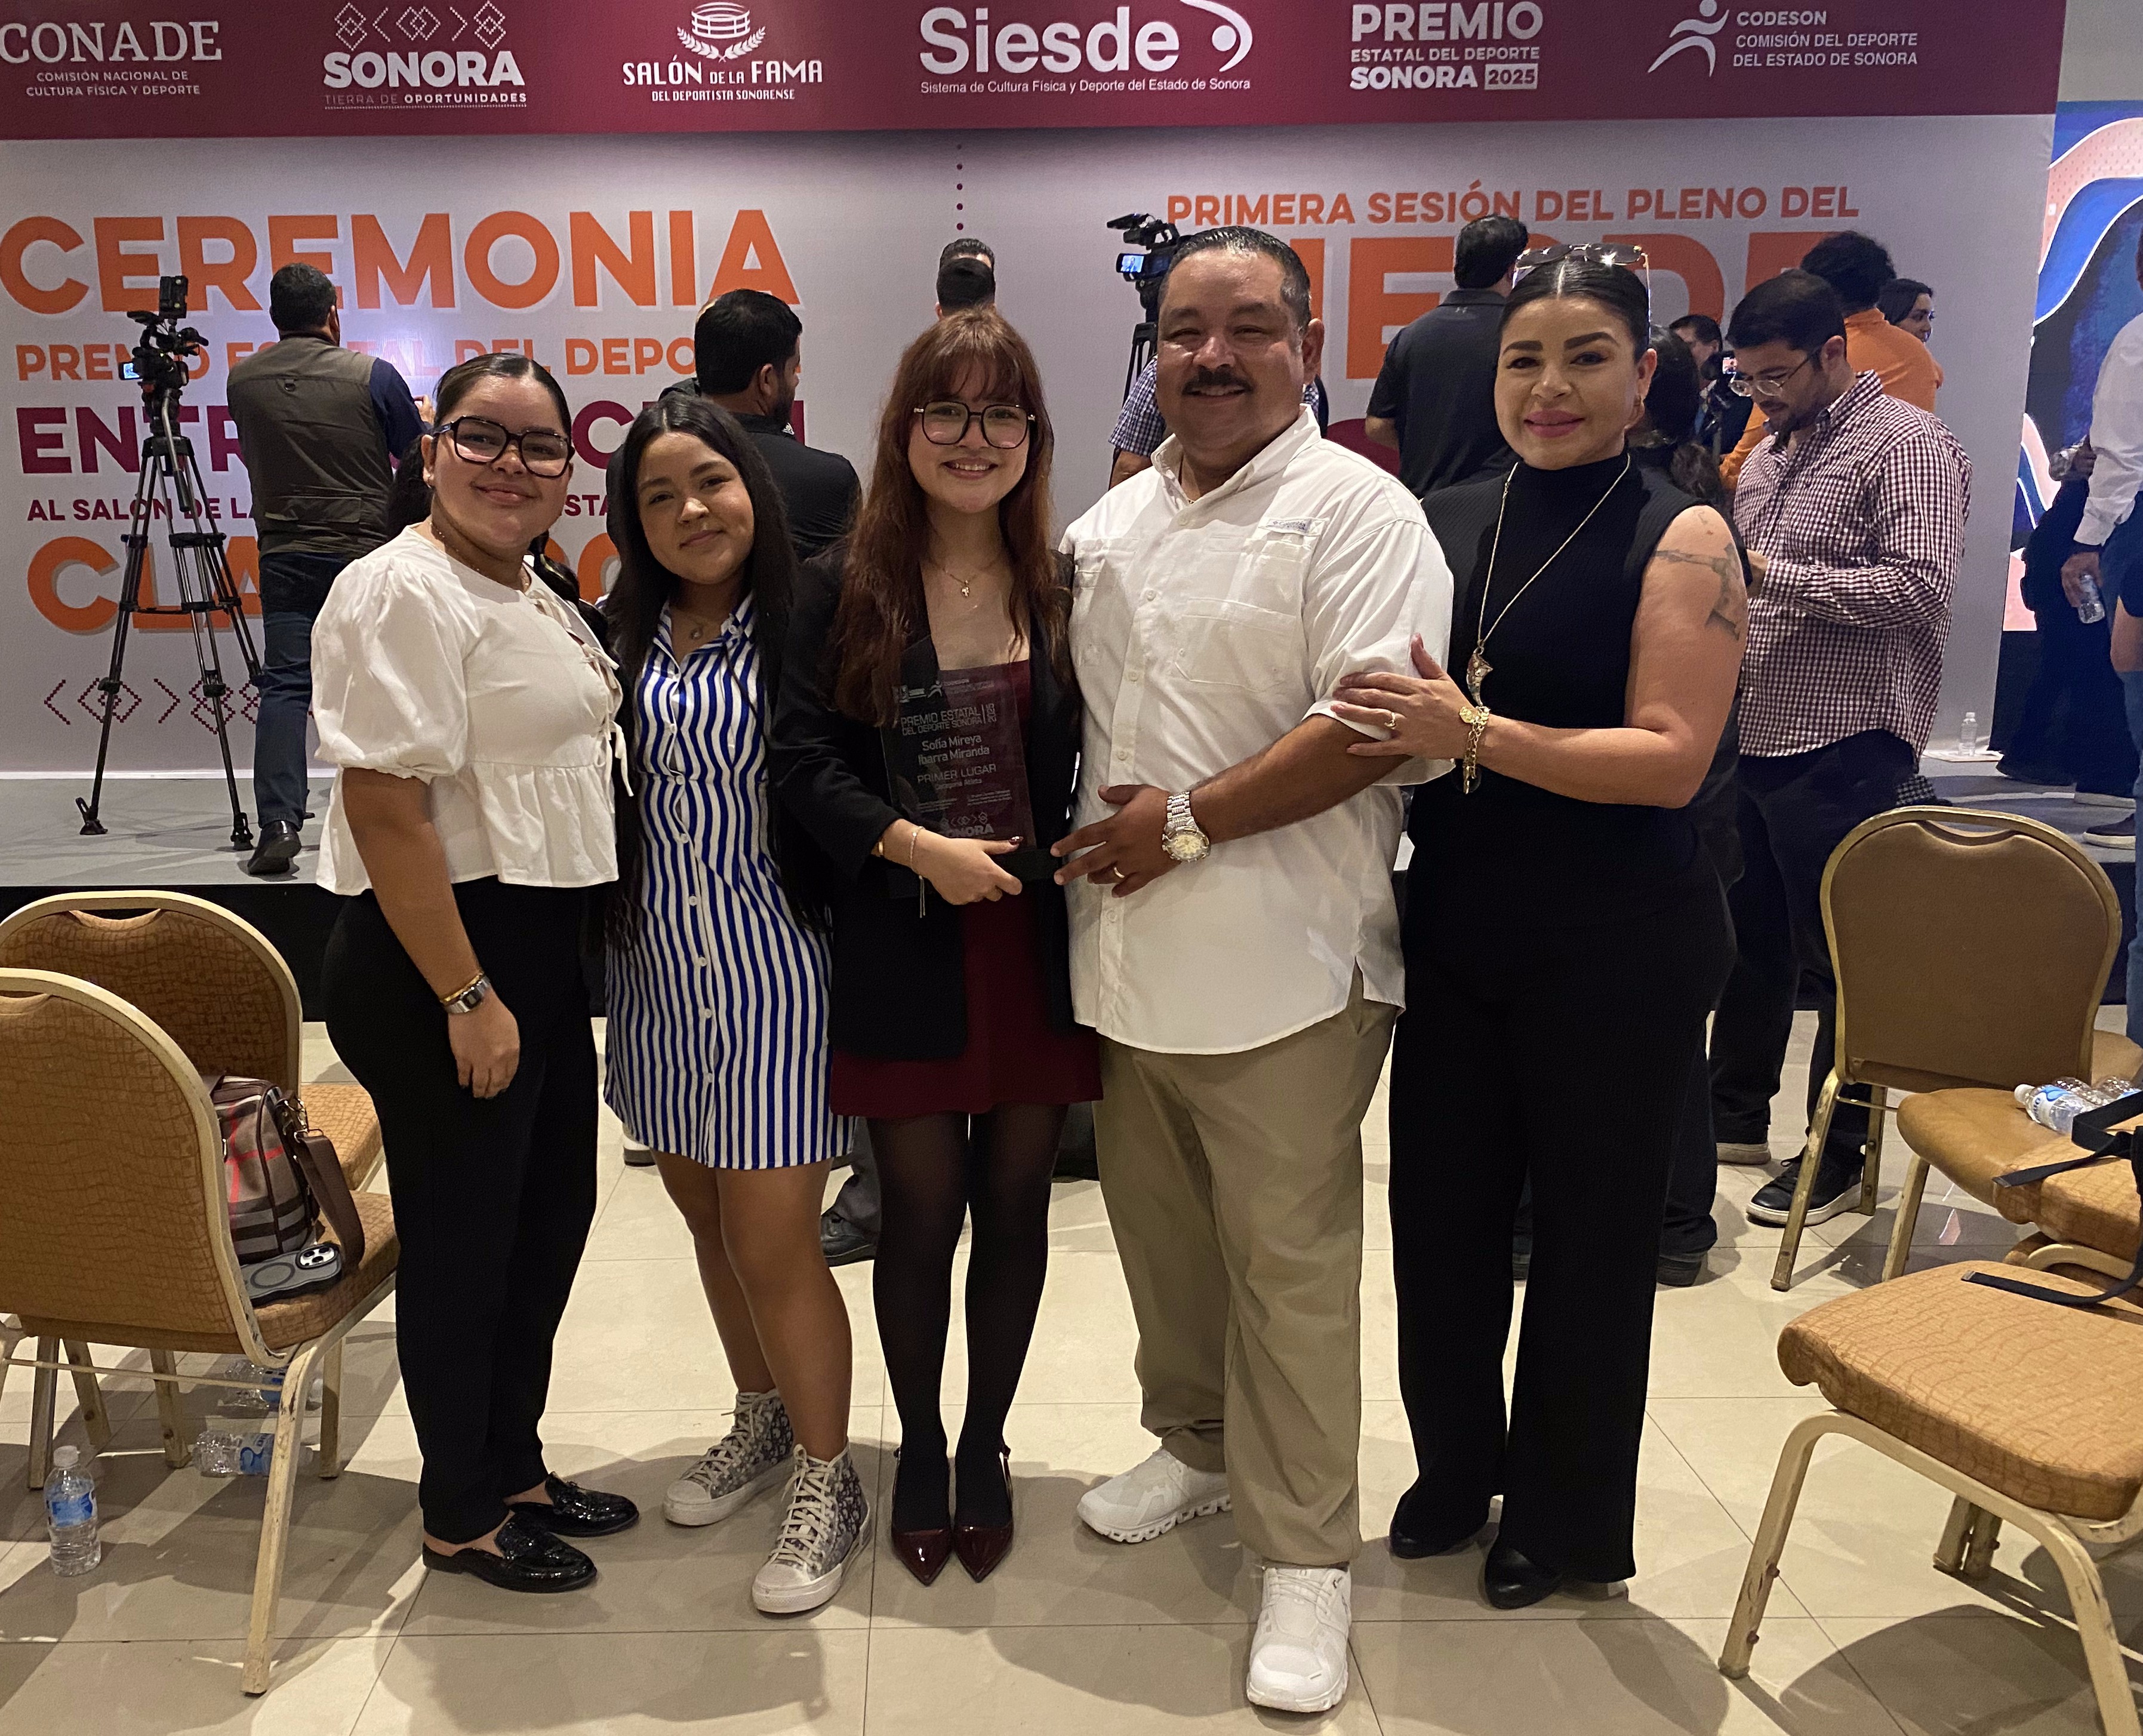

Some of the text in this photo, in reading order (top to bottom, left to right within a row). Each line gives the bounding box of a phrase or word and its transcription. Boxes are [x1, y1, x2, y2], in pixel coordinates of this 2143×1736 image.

[1352, 2, 1542, 42] PREMIO
[1737, 11, 1826, 26] CODESON
[0, 21, 221, 63] CONADE
[920, 6, 1179, 73] Siesde
[1736, 31, 1917, 47] COMISIÓN DEL DEPORTE
[1351, 47, 1539, 62] ESTATAL DEL DEPORTE
[1734, 53, 1917, 66] DEL ESTADO DE SONORA
[104, 72, 168, 81] NACIONAL
[172, 71, 188, 80] DE
[324, 51, 525, 88] SONORA
[623, 55, 822, 85] SALÓN DE LA FAMA
[1350, 66, 1536, 90] SONORA 2025
[26, 87, 83, 96] CULTURA
[131, 86, 137, 94] Y
[143, 85, 199, 94] DEPORTE
[652, 90, 795, 101] DEL DEPORTISTA SONORENSE
[922, 78, 1250, 94] Sistema de Cultura Física y Deporte del Estado de Sonora
[325, 93, 526, 106] TIERRA DE OPORTUNIDADES
[1167, 180, 1859, 227] PRIMERA SESIÓN DEL PLENO DEL
[0, 210, 800, 315] CEREMONIA
[27, 499, 65, 521] AL
[900, 706, 981, 728] PREMIO ESTATAL
[949, 735, 982, 747] Mireya
[918, 745, 990, 765] Ibarra Miranda
[917, 764, 997, 784] PRIMER LUGAR
[947, 823, 995, 838] ONORA
